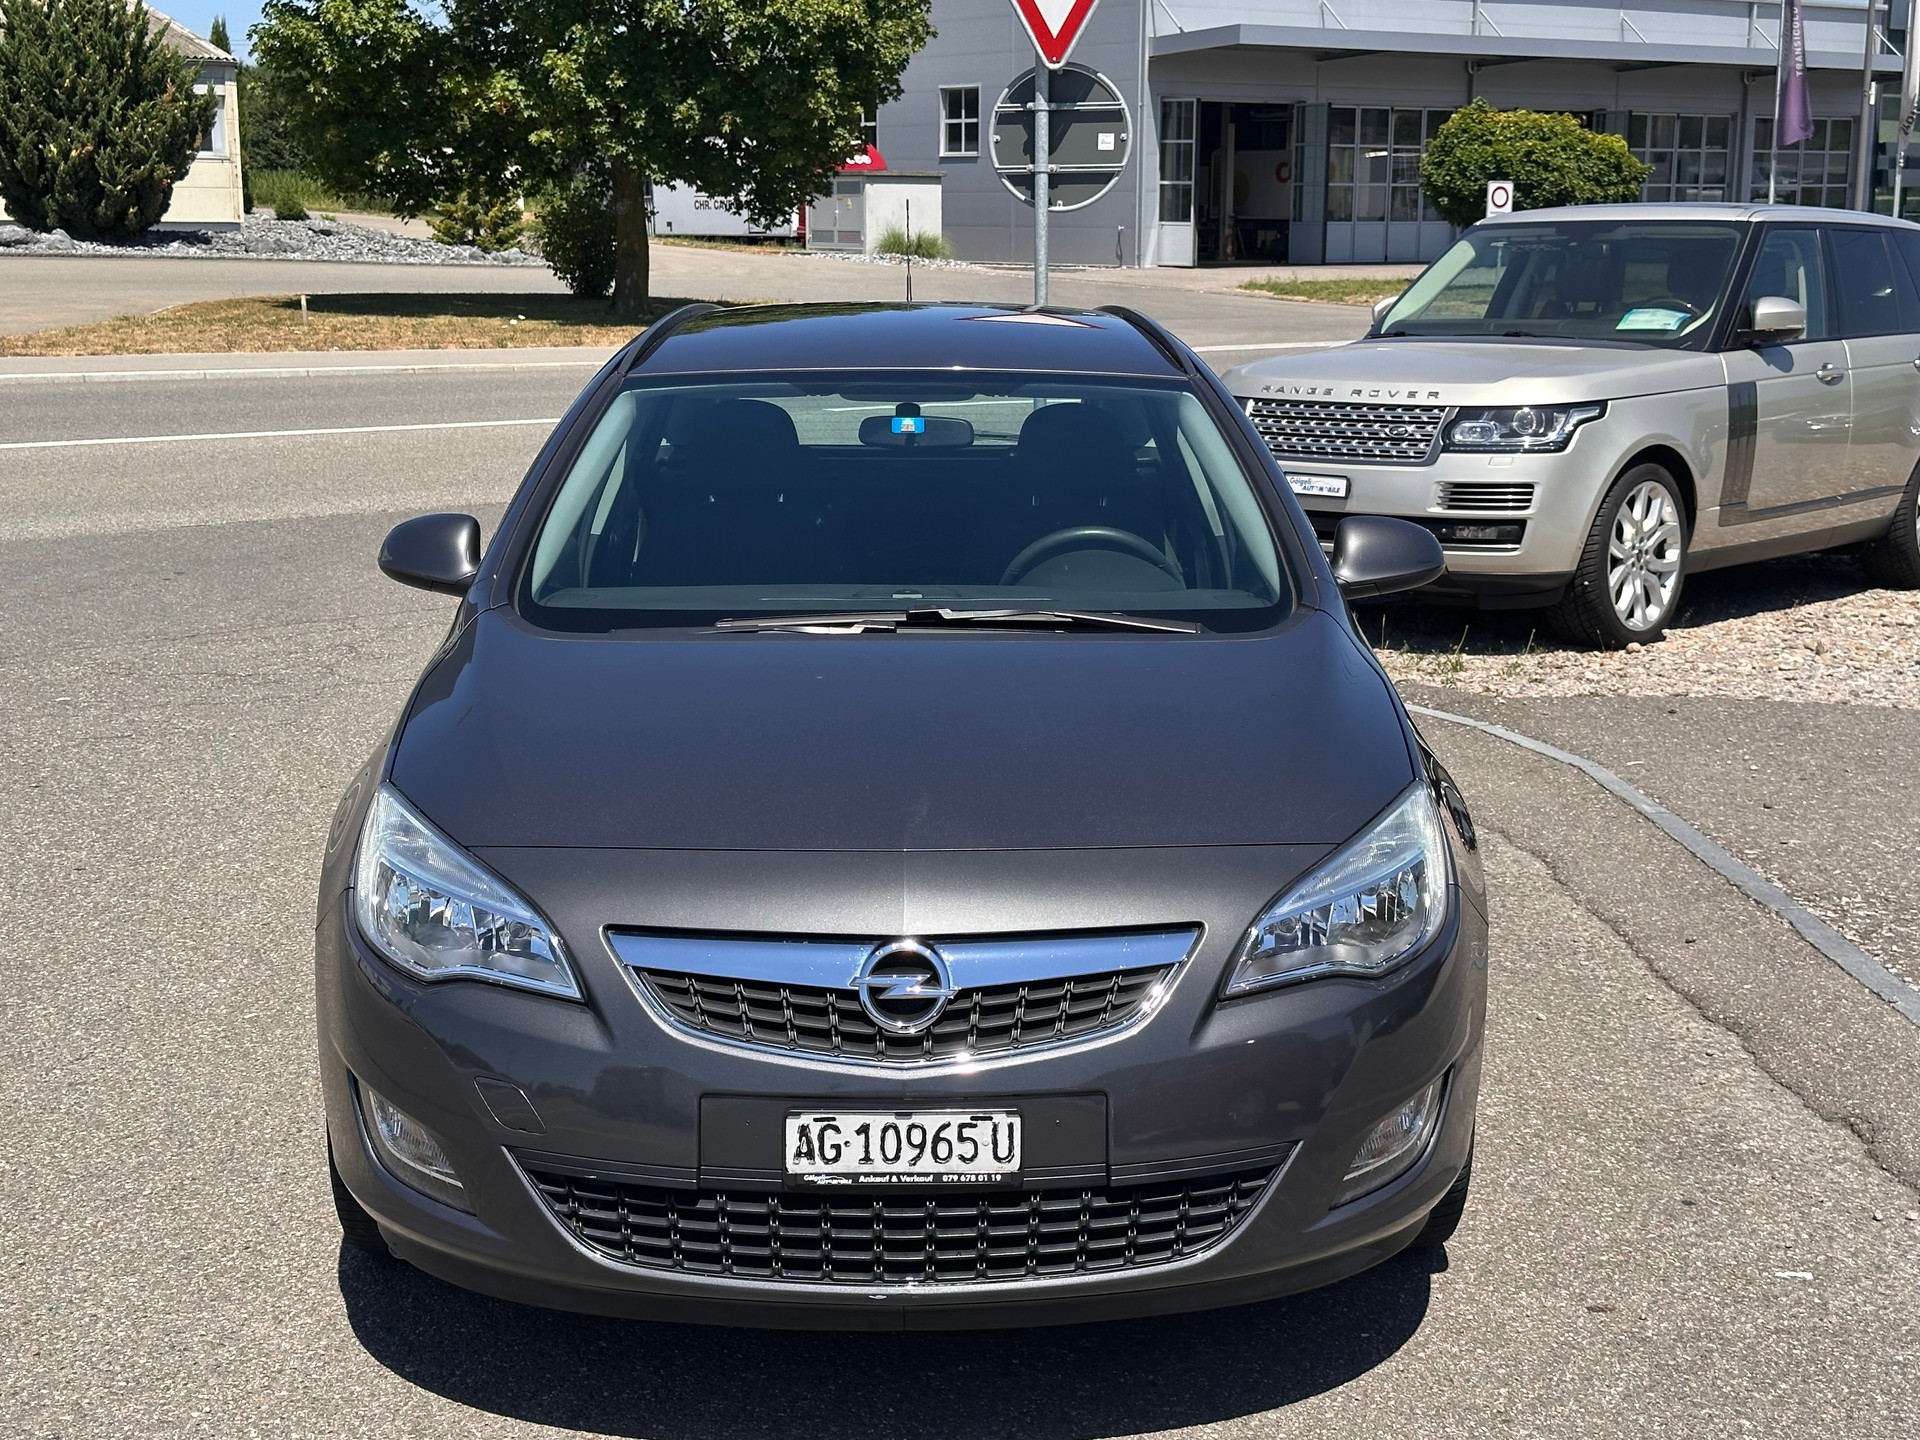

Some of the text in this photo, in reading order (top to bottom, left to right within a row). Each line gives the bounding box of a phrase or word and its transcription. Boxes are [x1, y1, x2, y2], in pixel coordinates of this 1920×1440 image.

[694, 200, 712, 210] CHR.
[1260, 384, 1440, 399] RANGE ROVER
[858, 1174, 1001, 1183] Ankauf & Verkauf 079 678 01 19
